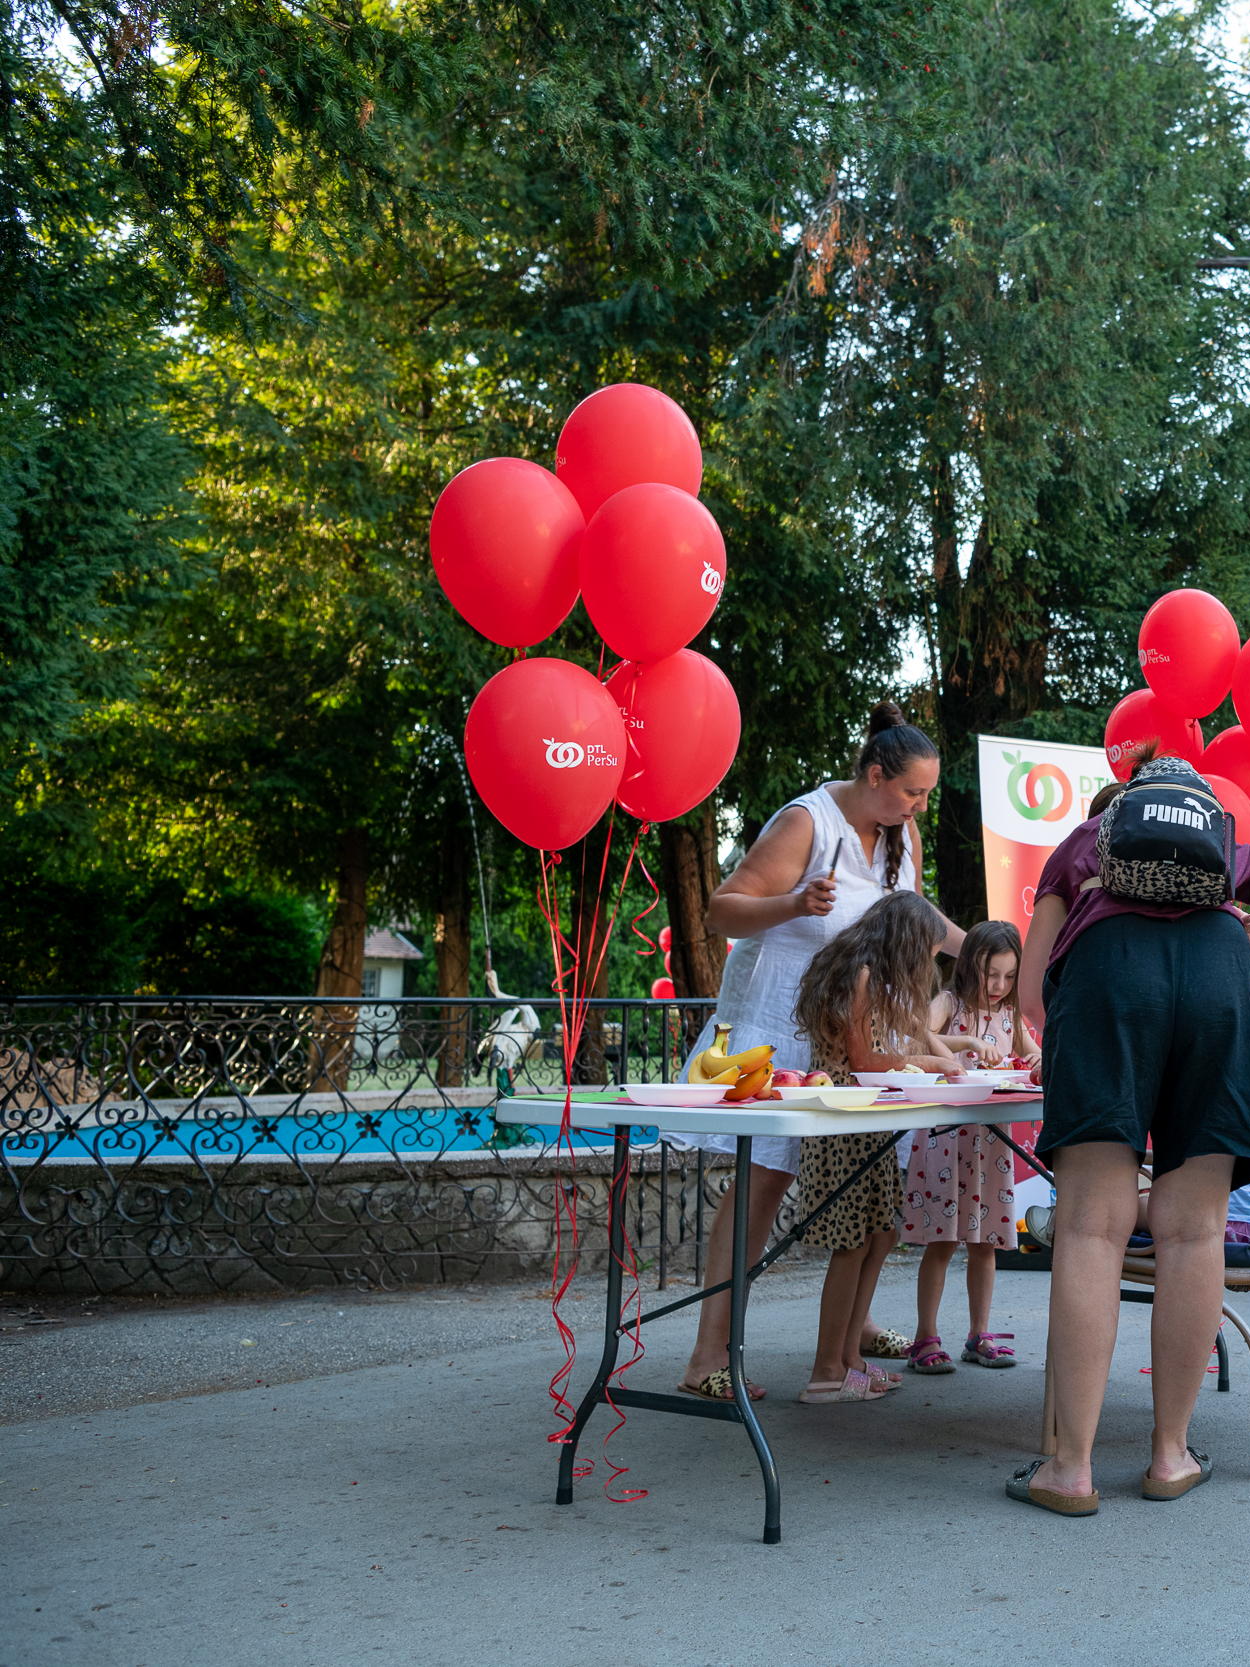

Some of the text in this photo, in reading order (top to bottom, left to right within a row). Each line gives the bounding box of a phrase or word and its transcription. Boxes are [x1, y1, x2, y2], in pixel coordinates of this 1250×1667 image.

[1148, 654, 1170, 664] PerSu
[587, 745, 606, 753] DTL
[1121, 740, 1134, 748] DTL
[587, 754, 617, 766] PerSu
[1143, 804, 1204, 831] PUMA
